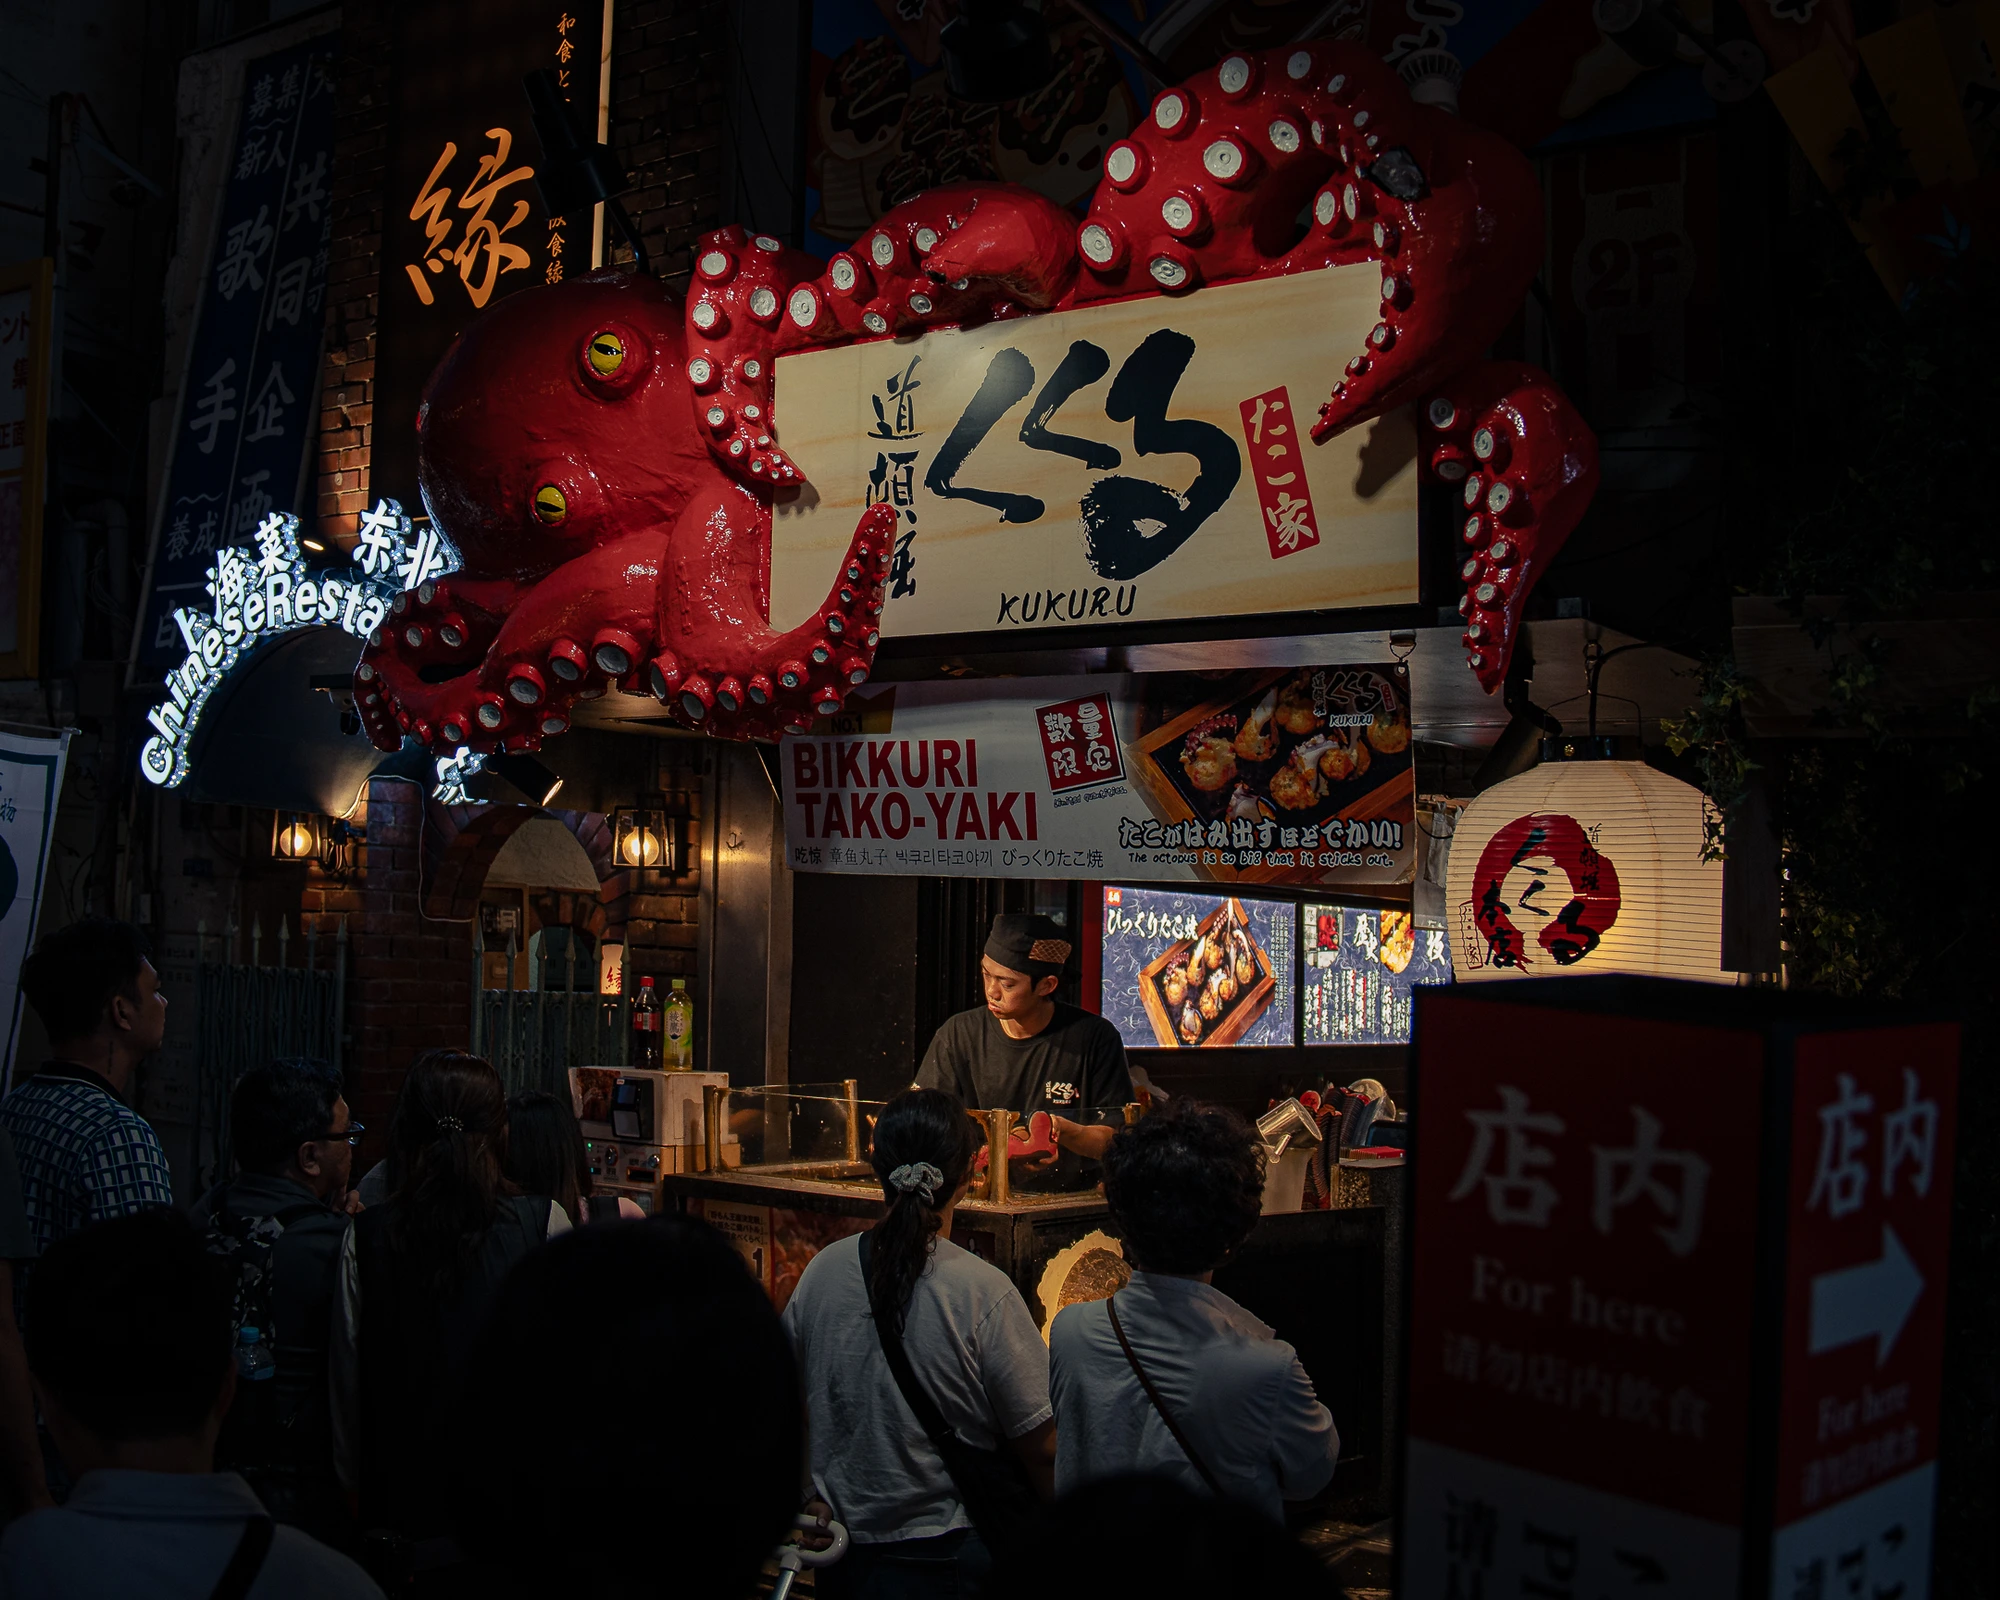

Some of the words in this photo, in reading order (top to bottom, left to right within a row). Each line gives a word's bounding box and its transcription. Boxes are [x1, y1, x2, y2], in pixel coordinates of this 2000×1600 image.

[555, 12, 576, 101] 和食と
[405, 127, 535, 309] 縁
[924, 328, 1241, 581] くくる
[1250, 397, 1316, 551] たこ家
[997, 584, 1137, 625] KUKURU
[831, 714, 863, 733] NO.1
[1329, 714, 1374, 727] KUKURU
[793, 739, 978, 788] BIKKURI
[796, 792, 1038, 841] TAKO-YAKI
[830, 847, 888, 866] 章鱼丸子
[1002, 848, 1104, 868] びっくりたこ焼
[1129, 852, 1148, 863] The
[1153, 852, 1197, 864] octopus
[1204, 851, 1216, 864] is
[1221, 853, 1236, 865] so
[1266, 852, 1295, 865] that
[1301, 852, 1315, 866] it
[1320, 852, 1362, 866] sticks
[1367, 853, 1394, 866] out.
[1804, 1064, 1941, 1222] 店内
[1447, 1083, 1714, 1260] 店内
[1471, 1252, 1557, 1318] For
[1568, 1272, 1689, 1348] here
